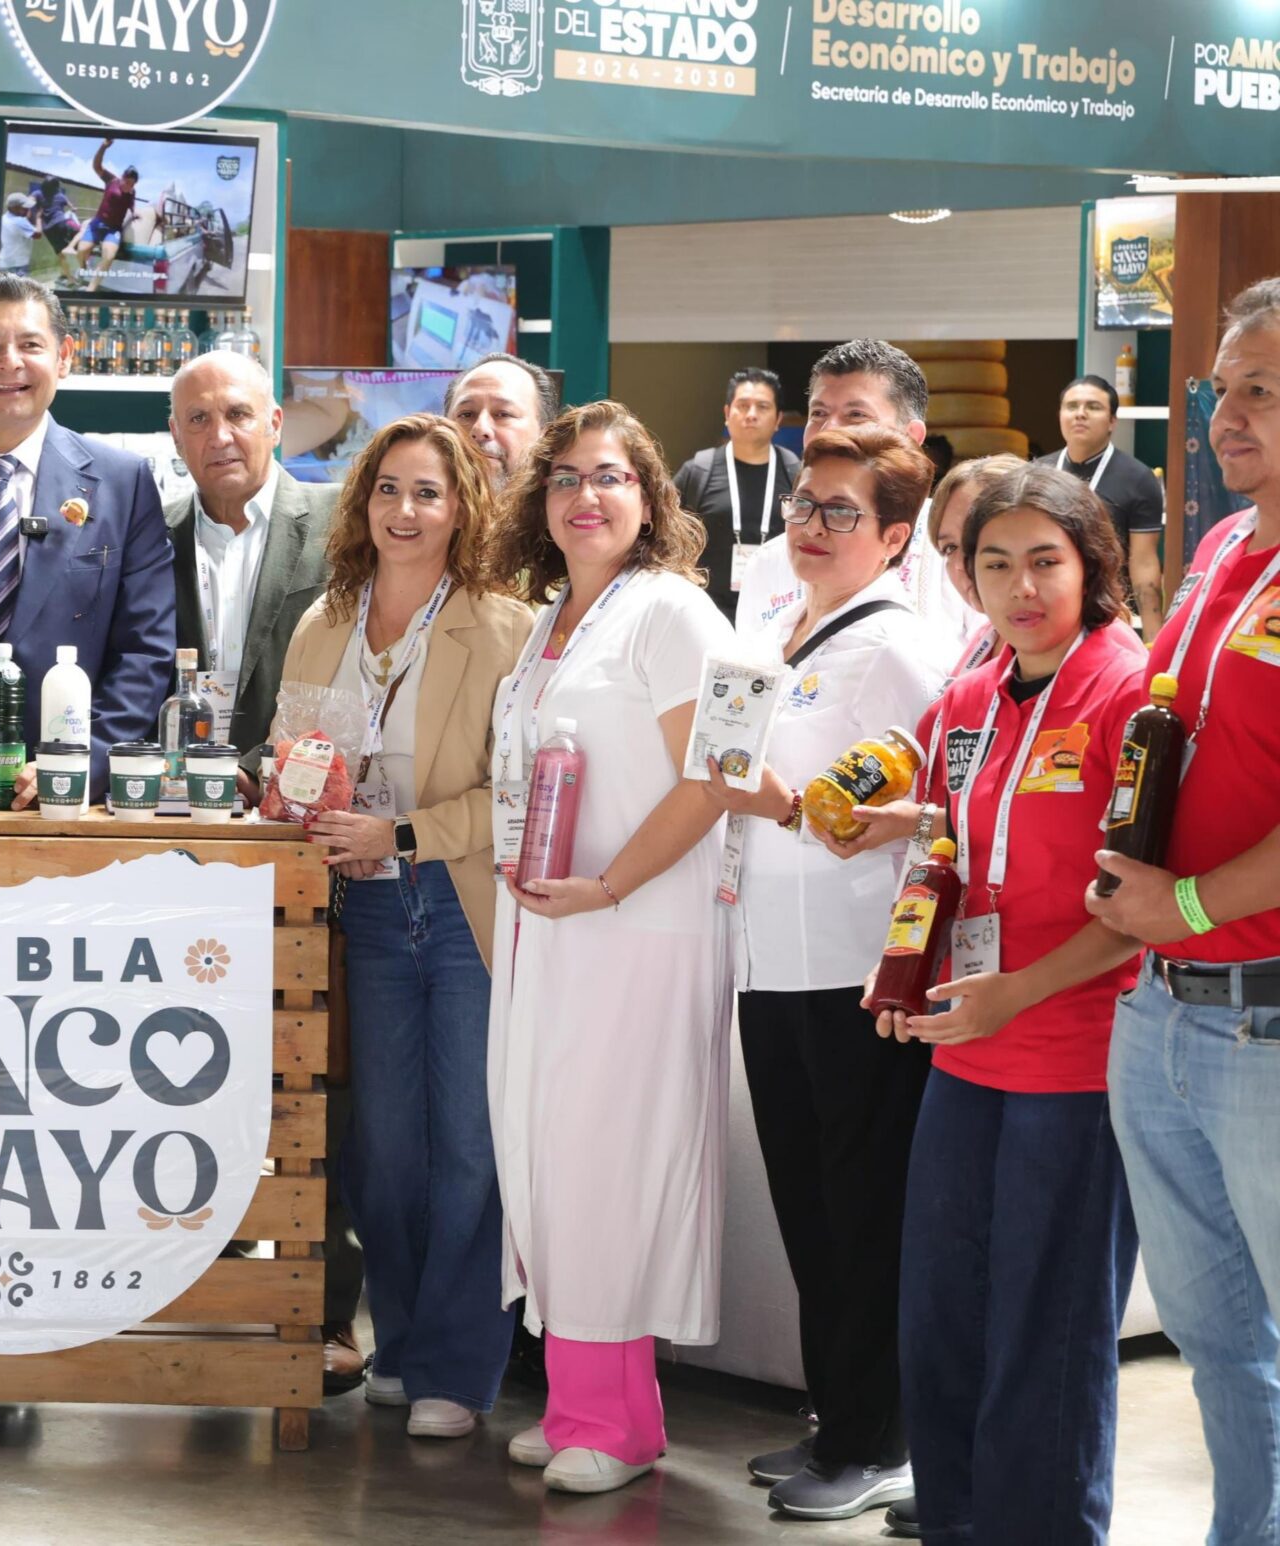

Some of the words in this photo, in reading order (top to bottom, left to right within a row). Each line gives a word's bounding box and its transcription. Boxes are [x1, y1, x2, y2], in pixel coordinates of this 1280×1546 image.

[61, 0, 248, 51] MAYO
[812, 0, 980, 35] Desarrollo
[555, 8, 596, 37] DEL
[600, 8, 757, 65] ESTADO
[812, 29, 985, 77] Económico
[992, 52, 1012, 87] y
[1018, 43, 1136, 94] Trabajo
[1194, 42, 1229, 67] POR
[66, 63, 119, 80] DESDE
[155, 70, 210, 86] 1862
[577, 57, 640, 80] 2024
[674, 67, 736, 89] 2030
[811, 81, 889, 104] Secretaría
[892, 88, 911, 105] de
[914, 89, 988, 110] Desarrollo
[991, 93, 1067, 114] Económico
[1070, 102, 1079, 118] y
[1082, 98, 1135, 121] Trabajo
[1113, 250, 1147, 264] CINCO
[770, 592, 794, 607] VIVE
[966, 647, 985, 669] CUVITEX
[947, 744, 976, 761] CINC
[953, 735, 978, 746] PUEBL
[998, 800, 1009, 838] SERVICIOS
[51, 1269, 144, 1290] 1862
